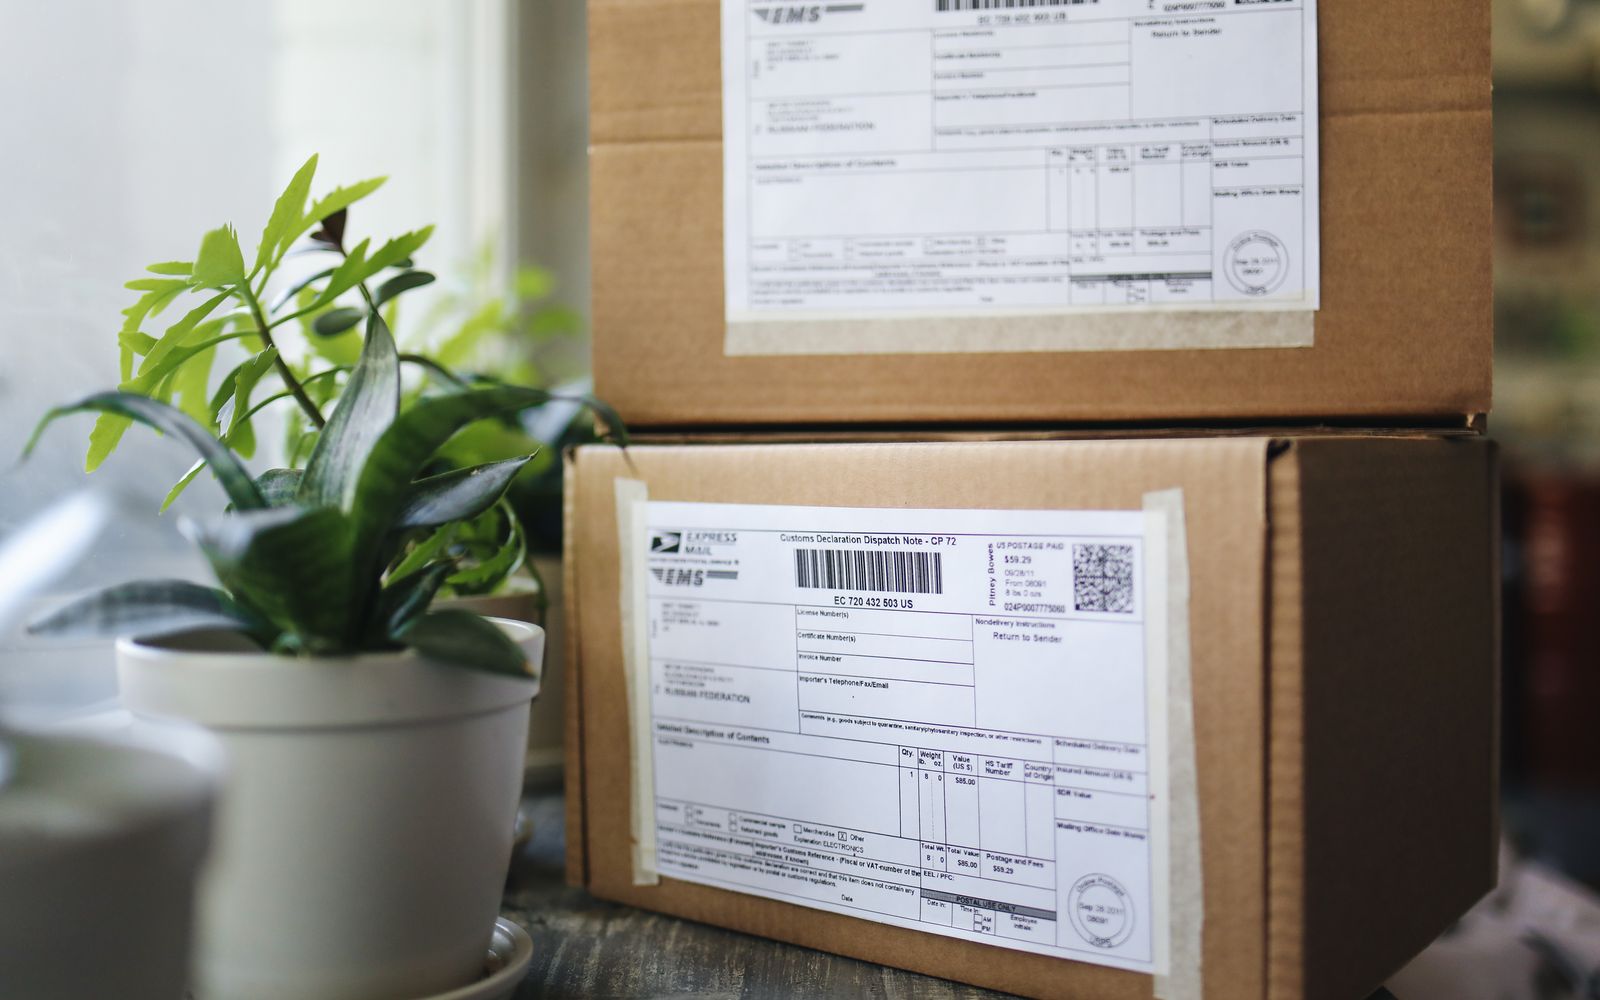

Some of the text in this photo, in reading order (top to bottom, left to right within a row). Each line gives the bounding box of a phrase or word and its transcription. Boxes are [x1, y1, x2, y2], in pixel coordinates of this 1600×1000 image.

[771, 5, 822, 24] EMS
[686, 532, 738, 543] EXPRESS
[780, 534, 815, 543] Customs
[816, 535, 862, 544] Declaration
[864, 536, 900, 546] Dispatch
[903, 537, 923, 546] Note
[930, 537, 944, 546] CP
[946, 537, 957, 546] 72
[685, 546, 712, 556] MAIL
[1006, 542, 1044, 550] POSTAGE
[665, 568, 704, 587] EMS
[1005, 579, 1024, 587] From
[989, 577, 997, 606] Pitney
[834, 596, 914, 608] EC 720 432 503 US
[797, 609, 849, 619] License Number(s)
[975, 618, 1056, 629] Nondelivery Instructions
[798, 632, 856, 643] Certificate Number(s)
[993, 632, 1062, 643] Return to Sender
[799, 653, 818, 661] Invoice
[799, 676, 889, 690] Importer's Telephone/Fax/Email
[700, 689, 750, 704] FEDERATION
[854, 718, 871, 726] subject
[737, 732, 770, 744] Contents
[902, 748, 914, 758] Qty.
[920, 751, 942, 760] Weight
[952, 754, 970, 763] Value
[966, 764, 972, 772] $)
[996, 761, 1014, 769] Tariff
[1024, 764, 1052, 773] Country
[985, 768, 1010, 776] Number
[1033, 772, 1054, 782] Origin
[955, 776, 976, 786] $85.00
[803, 826, 835, 837] Merchandise
[1056, 822, 1082, 833] Mailing
[1083, 825, 1103, 834] Office
[850, 834, 864, 842] Other
[823, 840, 864, 854] ELECTRONICS
[921, 842, 935, 850] Total
[947, 846, 961, 855] Total
[783, 846, 806, 857] Customs
[808, 851, 835, 862] Reference
[840, 857, 858, 867] (Fiscal
[866, 862, 902, 874] VAT-number
[958, 859, 978, 868] $85.00
[986, 853, 1012, 863] Postage
[1028, 860, 1044, 868] Fees
[992, 865, 1014, 874] $59.29
[860, 879, 874, 887] does
[884, 884, 904, 892] contain
[926, 899, 939, 907] Date
[956, 895, 1016, 912] POSTAL USE ONLY
[960, 906, 972, 914] Time
